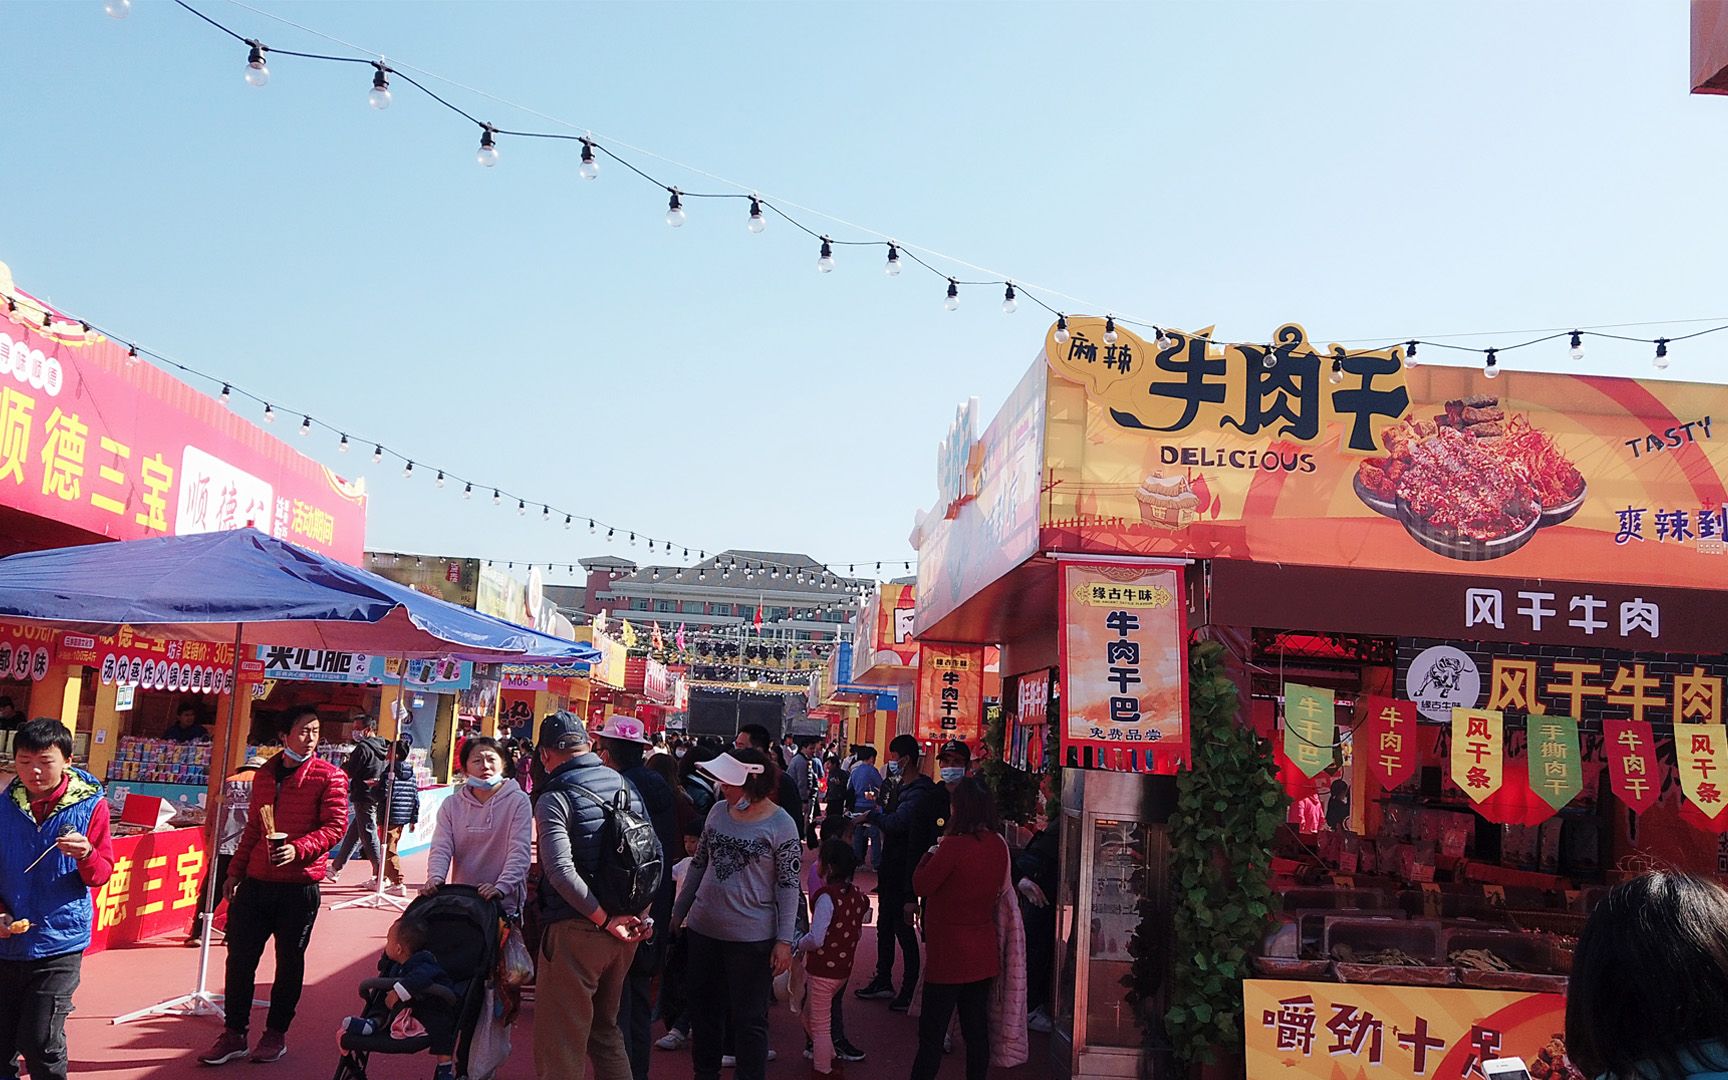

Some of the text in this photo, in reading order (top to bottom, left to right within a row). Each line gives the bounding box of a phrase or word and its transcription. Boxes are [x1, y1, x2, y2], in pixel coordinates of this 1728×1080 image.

[1067, 333, 1132, 375] 麻辣
[1110, 326, 1410, 451] 牛肉干
[1626, 416, 1713, 458] TASTY
[1615, 505, 1728, 546] 爽辣到
[1092, 587, 1153, 601] 缘古牛味
[1465, 587, 1660, 638] 风干牛肉
[508, 677, 529, 687] M06
[1107, 611, 1141, 721] 牛肉干巴
[1486, 658, 1723, 724] 风干牛肉
[941, 672, 960, 730] 牛肉干巴
[1089, 727, 1161, 740] 免费品尝
[1298, 696, 1323, 765] 牛干巴
[1379, 706, 1403, 776] 牛肉干
[1465, 717, 1492, 789] 风干条
[1539, 723, 1571, 795] 手撕肉干
[1617, 729, 1650, 801] 牛肉干
[1690, 733, 1721, 805] 风干条
